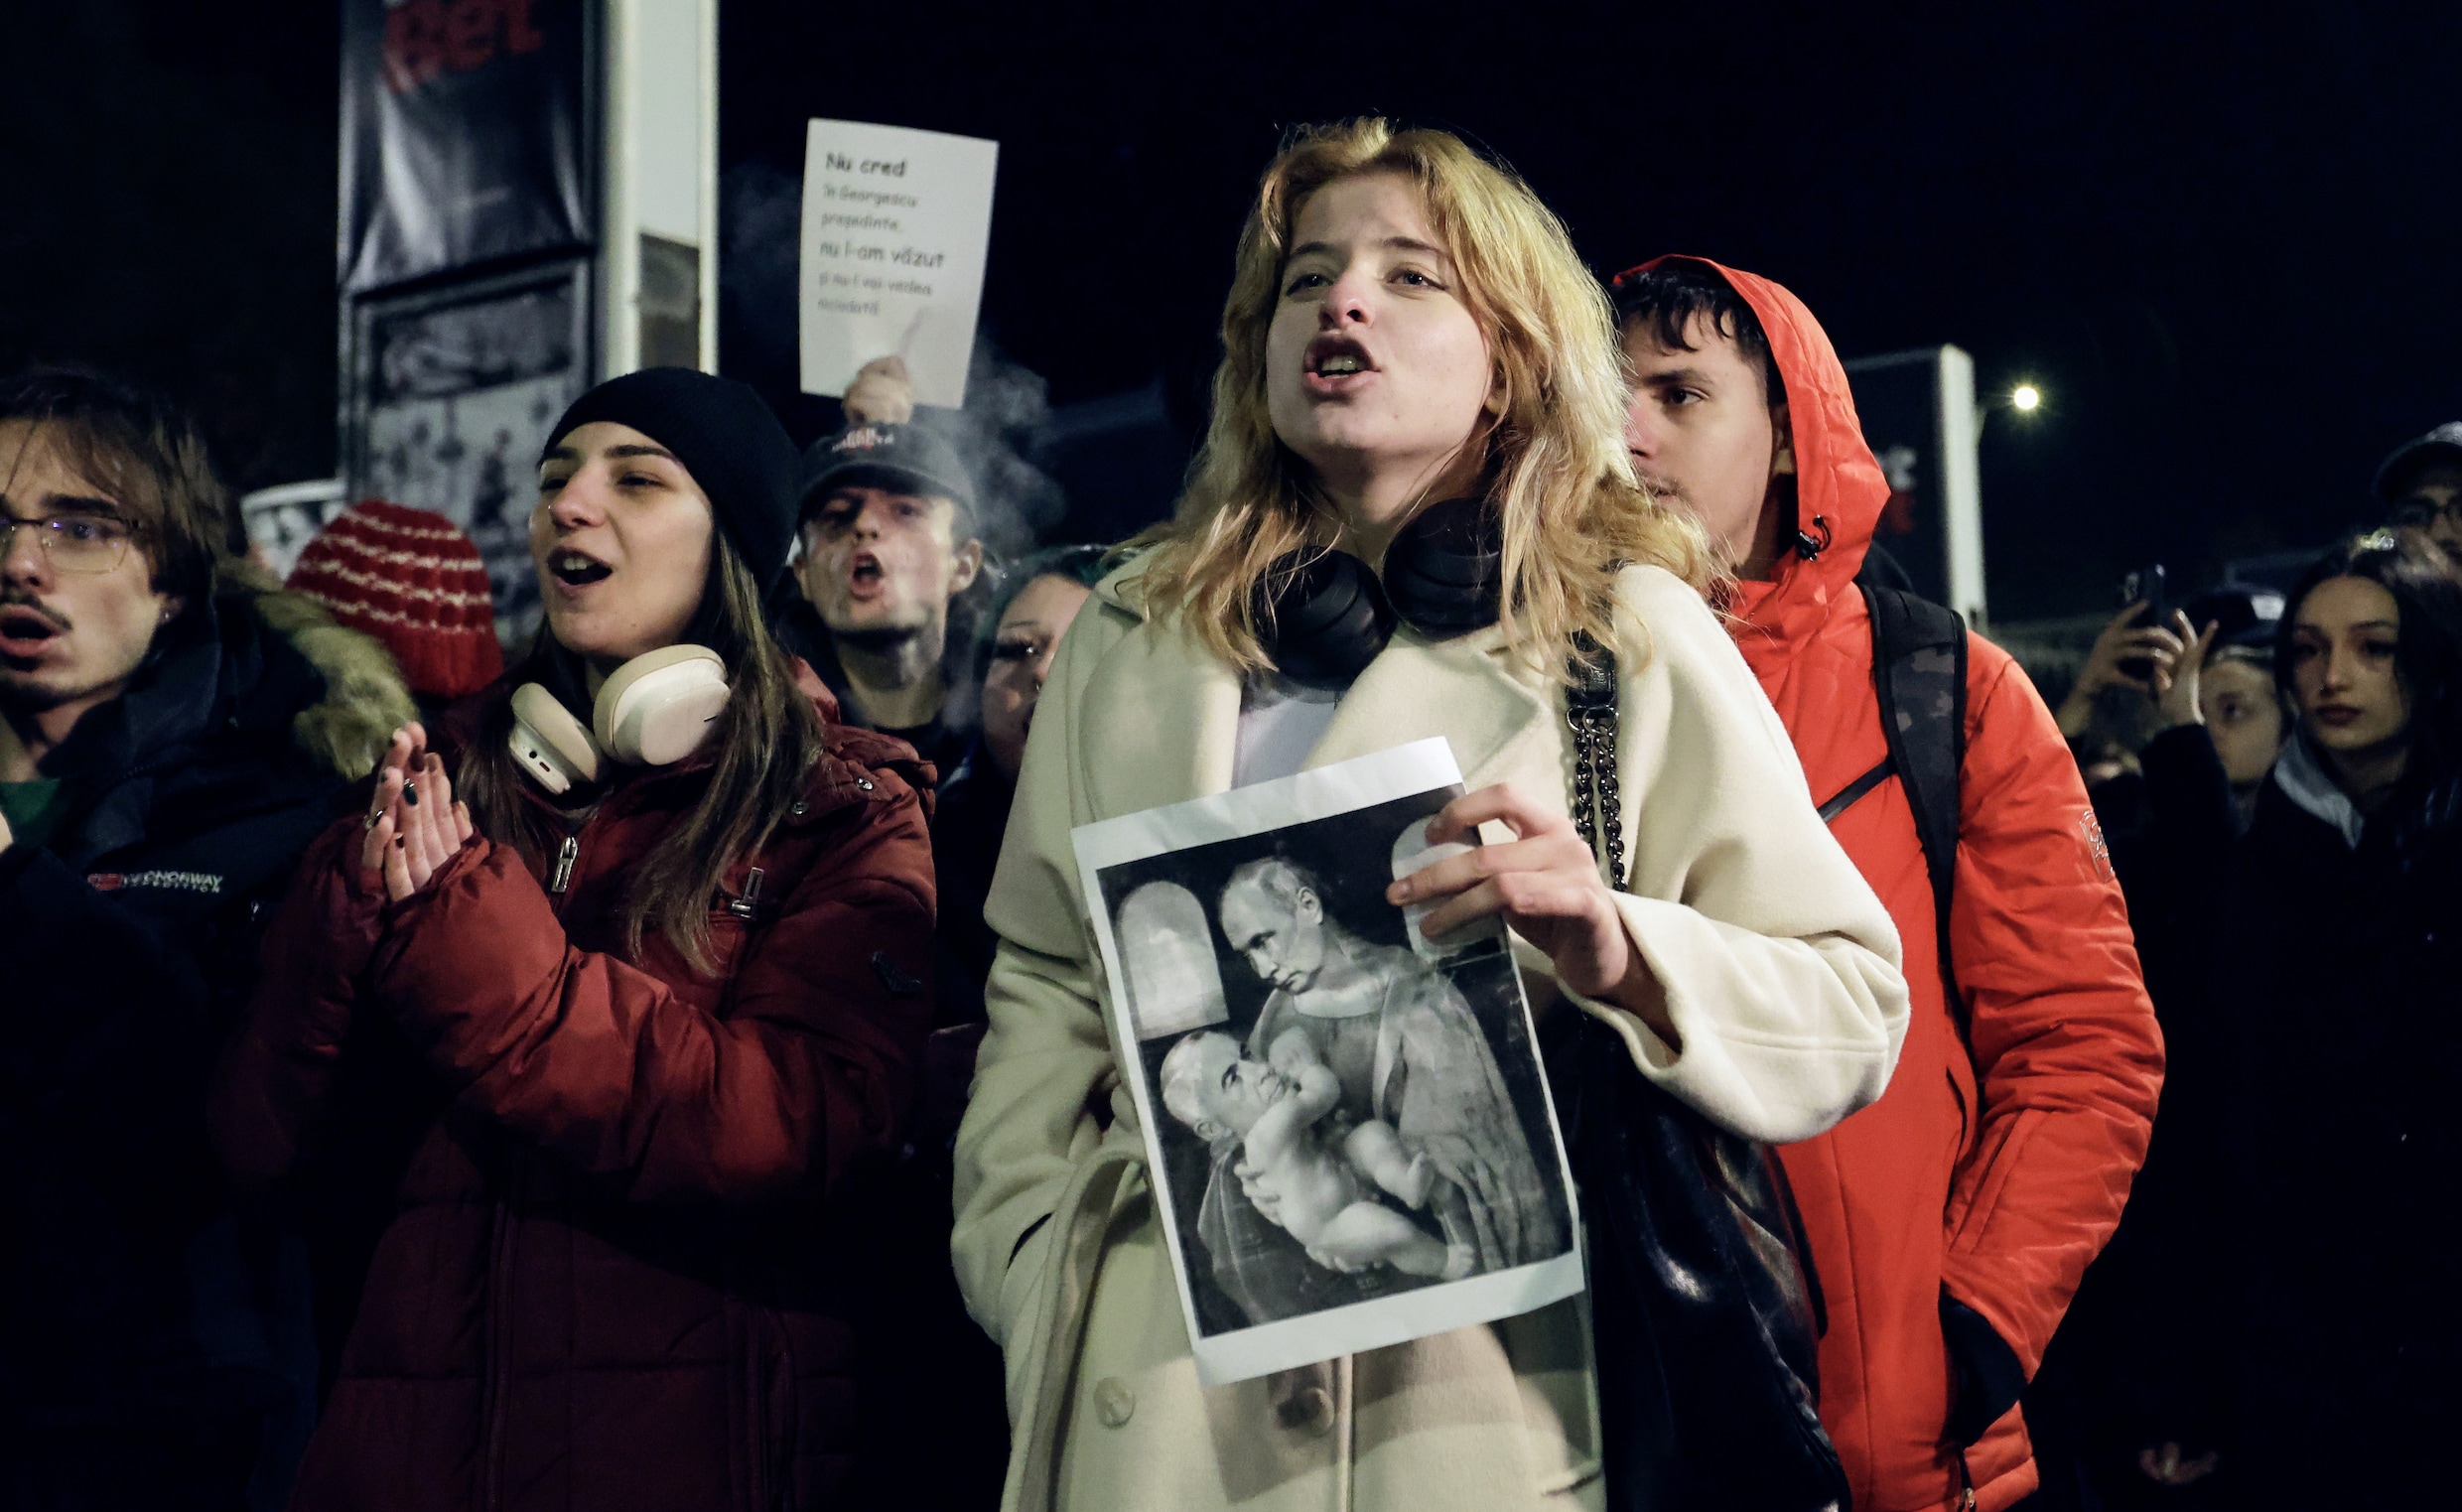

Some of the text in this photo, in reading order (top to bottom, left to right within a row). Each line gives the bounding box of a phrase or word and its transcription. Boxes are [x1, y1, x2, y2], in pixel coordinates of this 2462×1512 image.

[826, 152, 906, 178] Nu cred
[840, 186, 917, 207] Georgescu
[820, 240, 944, 269] nu l-am văzut
